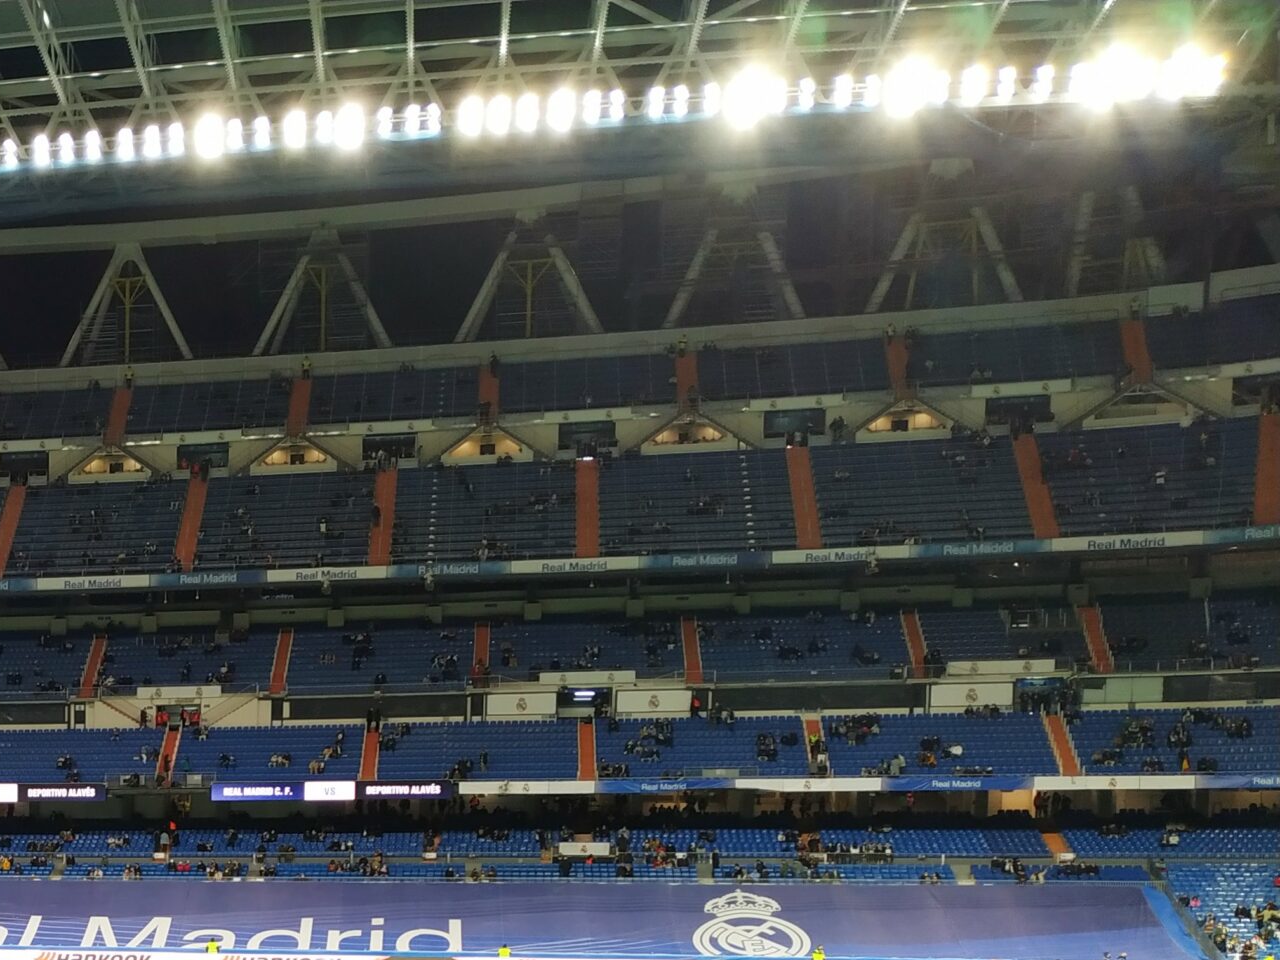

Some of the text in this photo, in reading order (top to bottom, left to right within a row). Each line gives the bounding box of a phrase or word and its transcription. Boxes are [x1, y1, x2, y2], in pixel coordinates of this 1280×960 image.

[943, 542, 1014, 555] Real Madrid
[1088, 537, 1166, 550] Real Madrid
[672, 554, 738, 566] Real Madrid
[805, 552, 831, 562] Real
[443, 564, 479, 574] Madrid
[542, 560, 608, 572] Real Madrid
[180, 574, 237, 584] Real Madrid
[296, 571, 318, 580] Real
[64, 579, 122, 589] Real Madrid
[641, 782, 687, 790] Real Madrid
[932, 779, 981, 788] Real Madrid
[27, 786, 96, 797] DEPORTIVO ALAVÉS
[223, 786, 242, 796] REAL
[243, 786, 273, 796] MADRID
[324, 786, 336, 796] VS
[366, 783, 442, 796] DEPORTIVO ALAVÉS
[78, 915, 462, 953] Madrid
